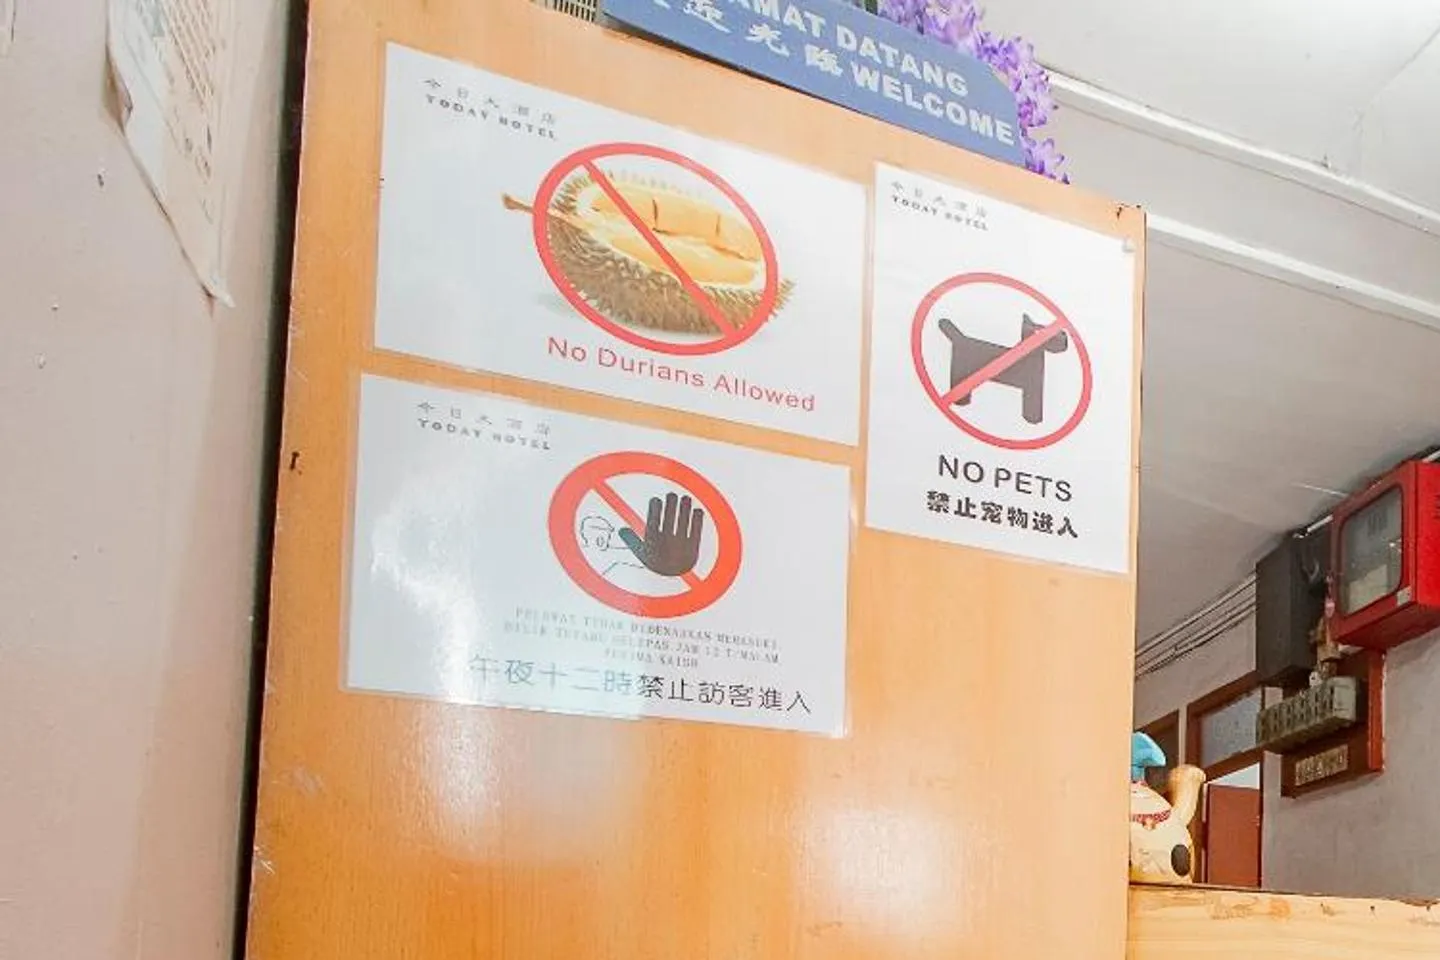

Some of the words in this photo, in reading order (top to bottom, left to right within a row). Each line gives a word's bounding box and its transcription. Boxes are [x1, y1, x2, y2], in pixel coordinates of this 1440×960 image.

[837, 25, 969, 95] DATANG
[425, 93, 490, 120] TODAY
[499, 115, 557, 141] HOTEL
[852, 61, 1015, 146] WELCOME
[891, 194, 937, 216] TODAY
[548, 336, 587, 363] No
[599, 347, 704, 388] Durians
[714, 376, 816, 412] Allowed
[418, 418, 481, 438] TODAY
[493, 433, 550, 450] HOTEL
[938, 454, 985, 483] NO
[994, 467, 1072, 502] PETS
